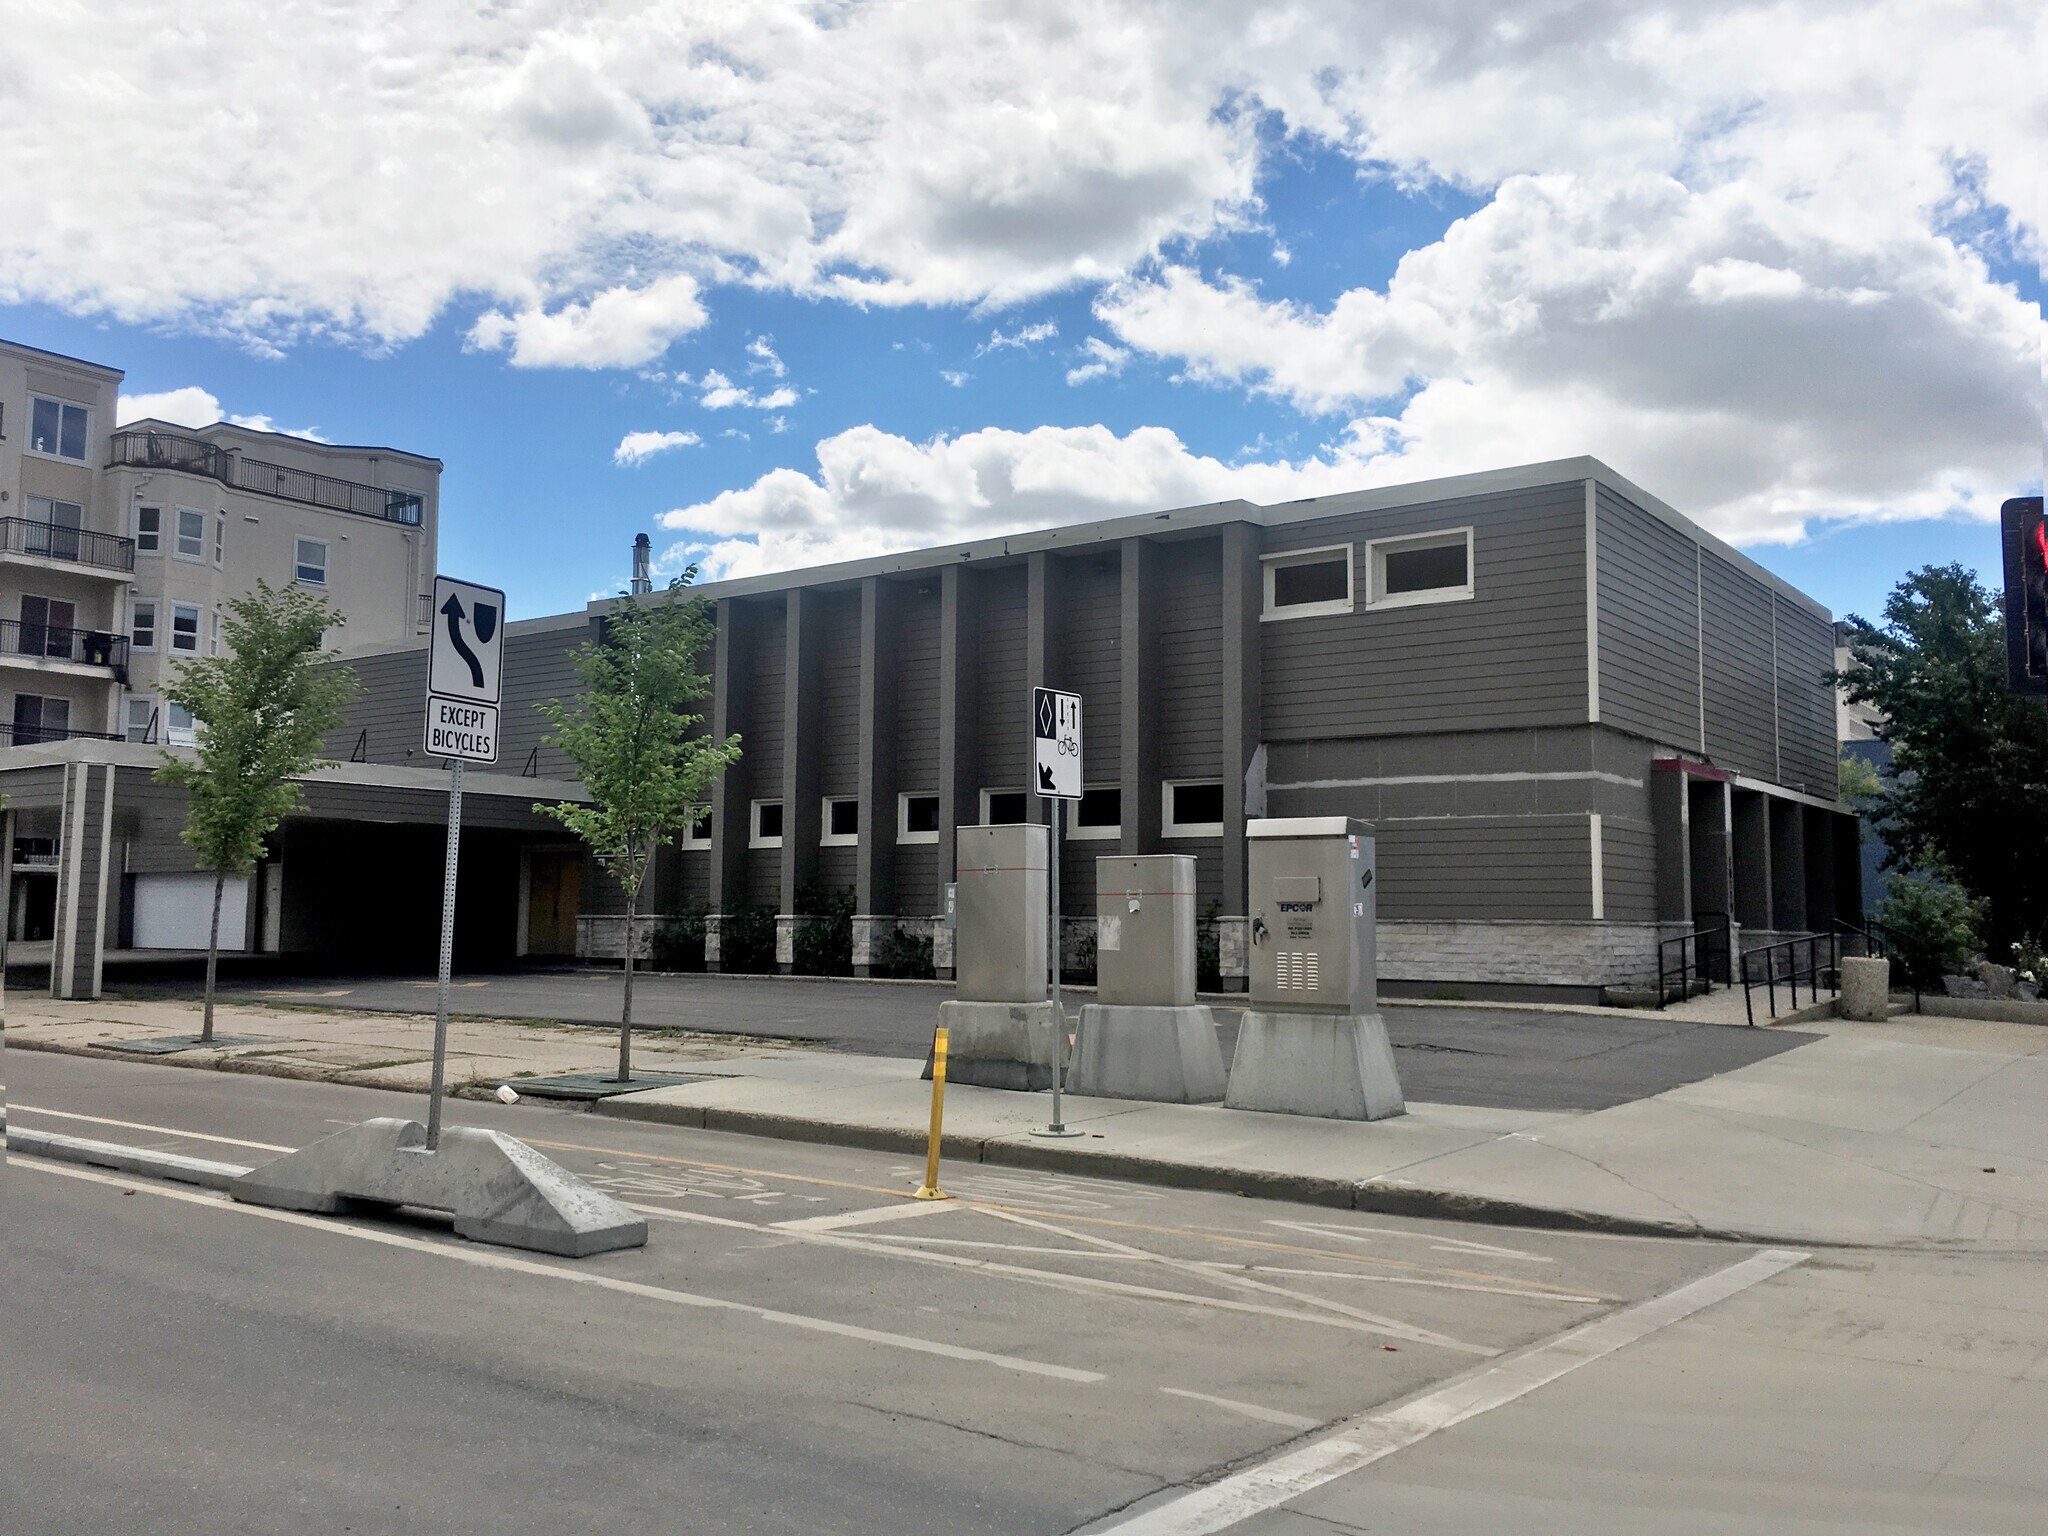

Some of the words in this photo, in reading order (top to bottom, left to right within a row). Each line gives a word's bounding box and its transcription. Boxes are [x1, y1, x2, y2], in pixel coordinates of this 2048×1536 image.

[440, 705, 486, 729] EXCEPT
[433, 728, 490, 754] BICYCLES
[1280, 903, 1313, 912] EPCOR
